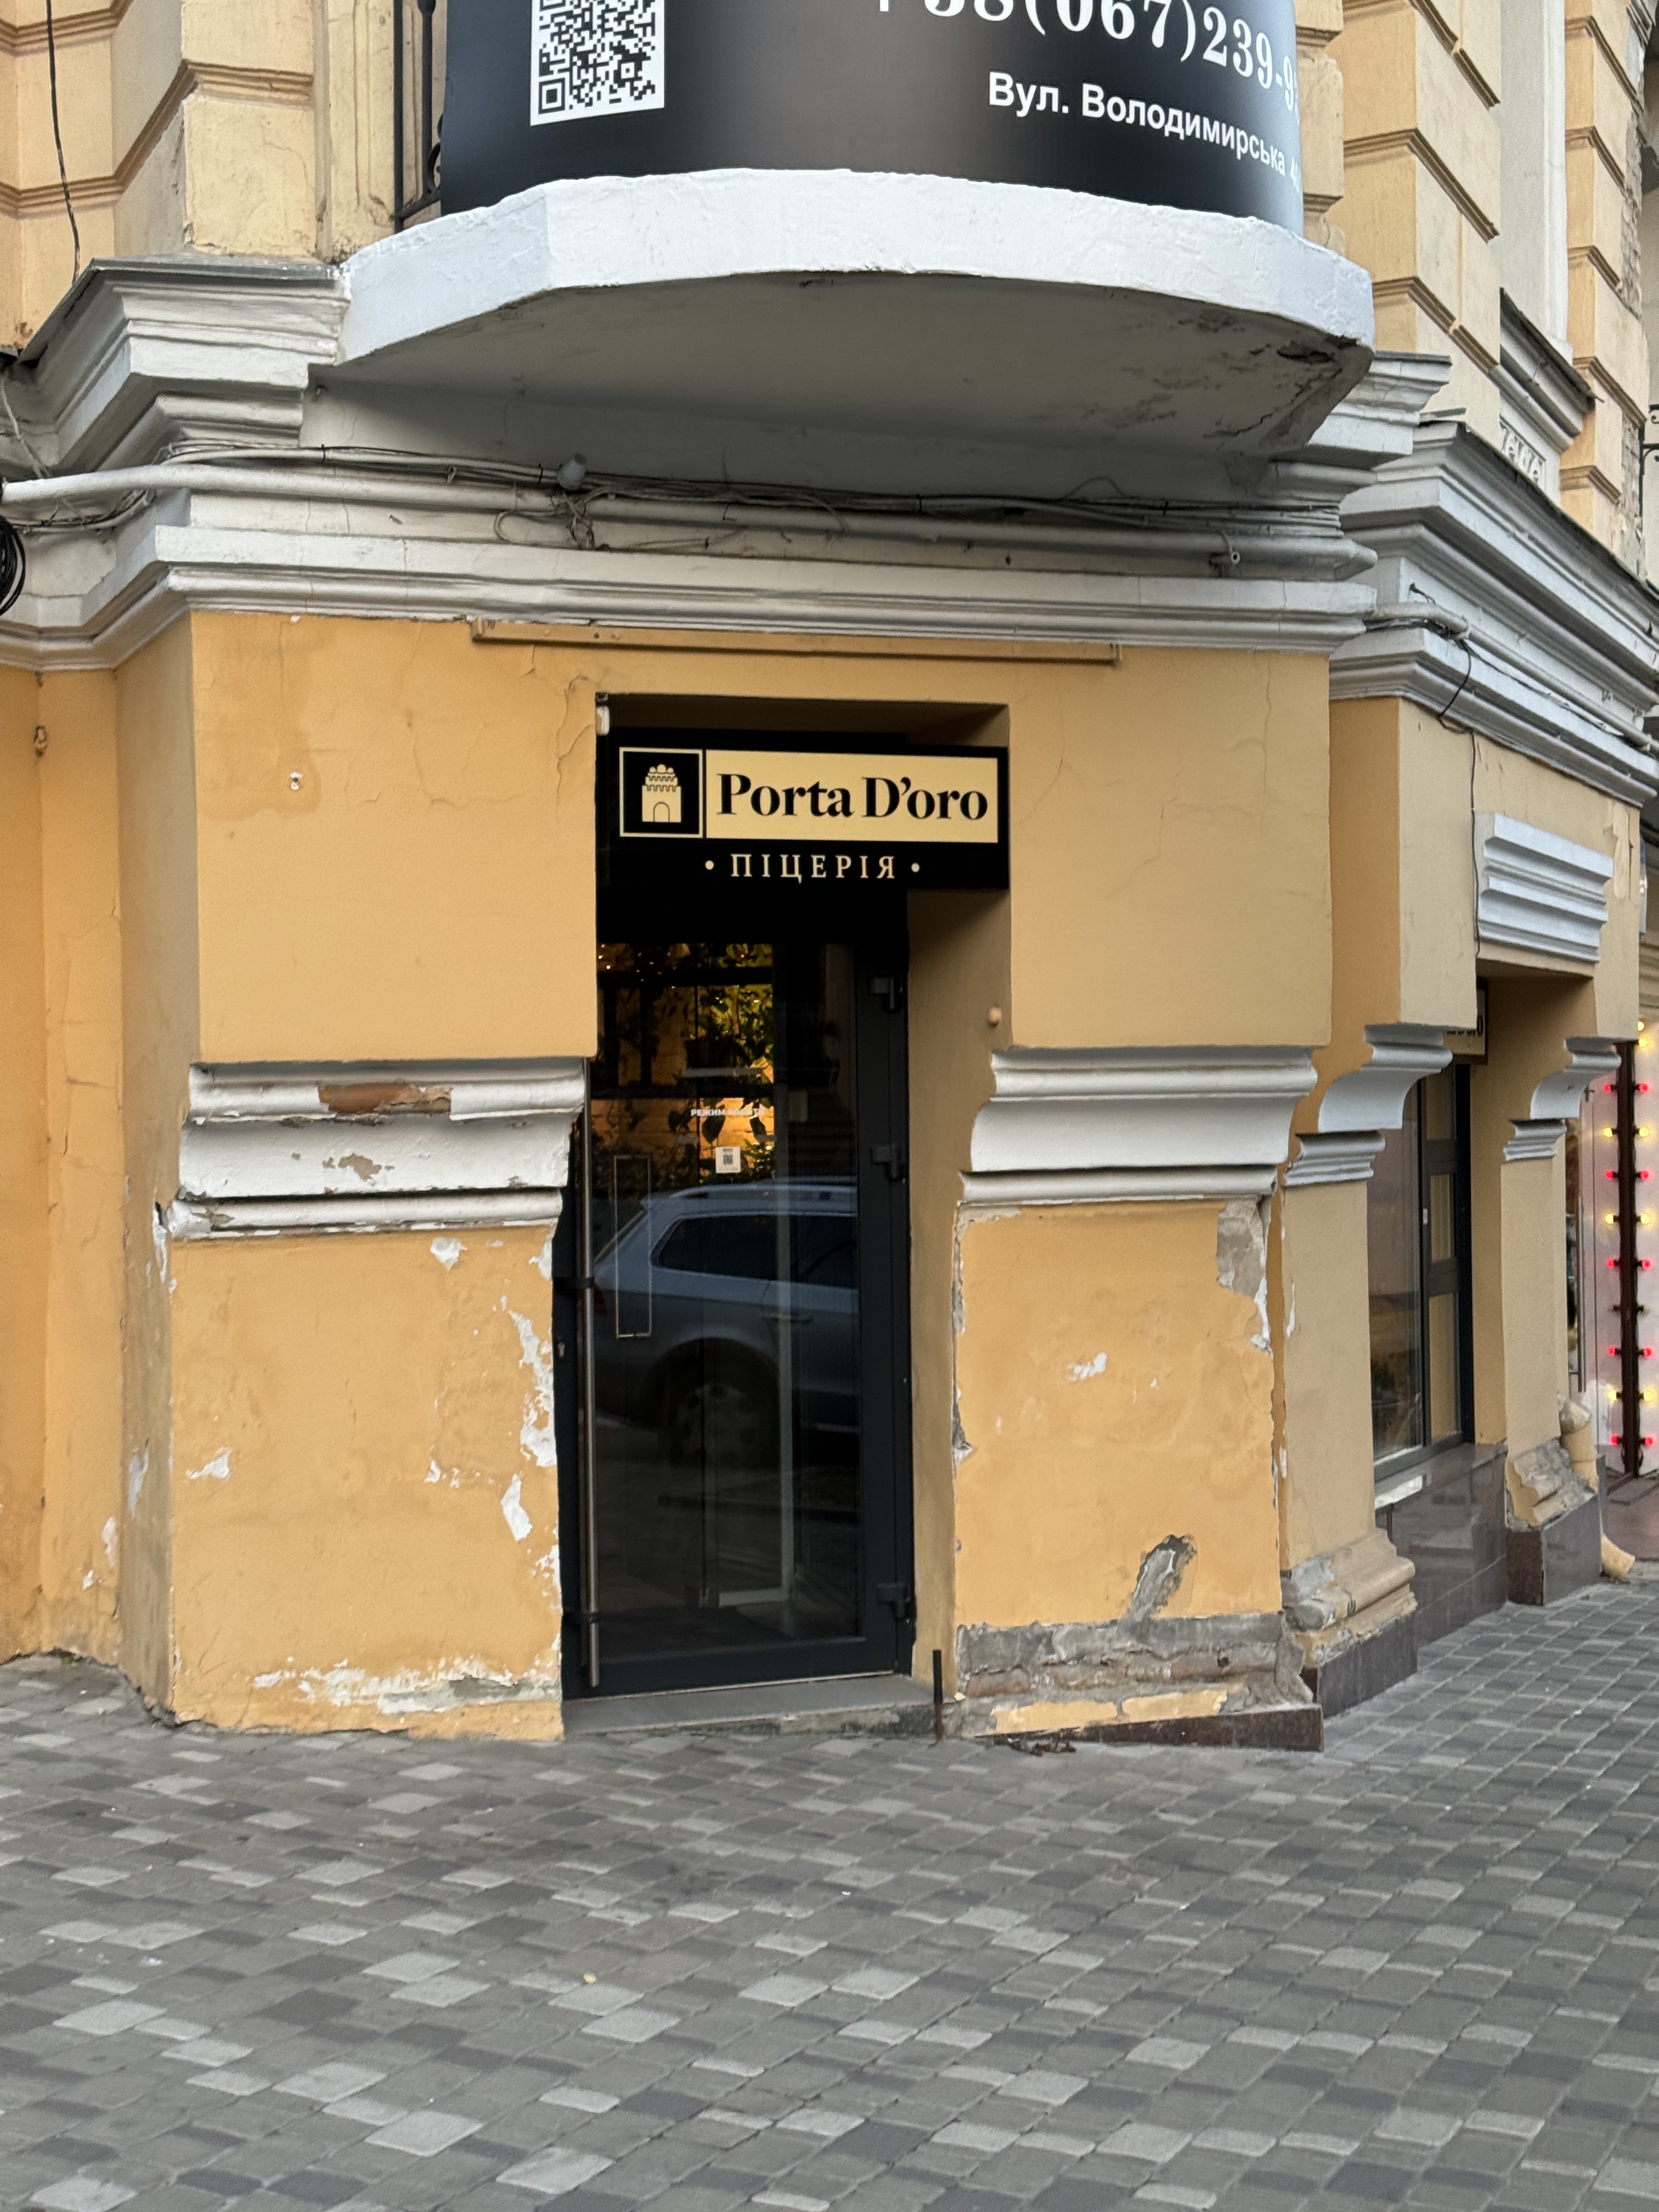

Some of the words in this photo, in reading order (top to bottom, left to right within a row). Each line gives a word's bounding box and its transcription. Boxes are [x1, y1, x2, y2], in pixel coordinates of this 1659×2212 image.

[989, 71, 1069, 117] Вул.
[1082, 83, 1286, 177] Володимирська
[716, 773, 855, 817] Porta
[861, 776, 988, 820] D’oro
[730, 853, 895, 884] ПІЦЕРІЯ
[691, 1109, 725, 1117] РЕЖИМ
